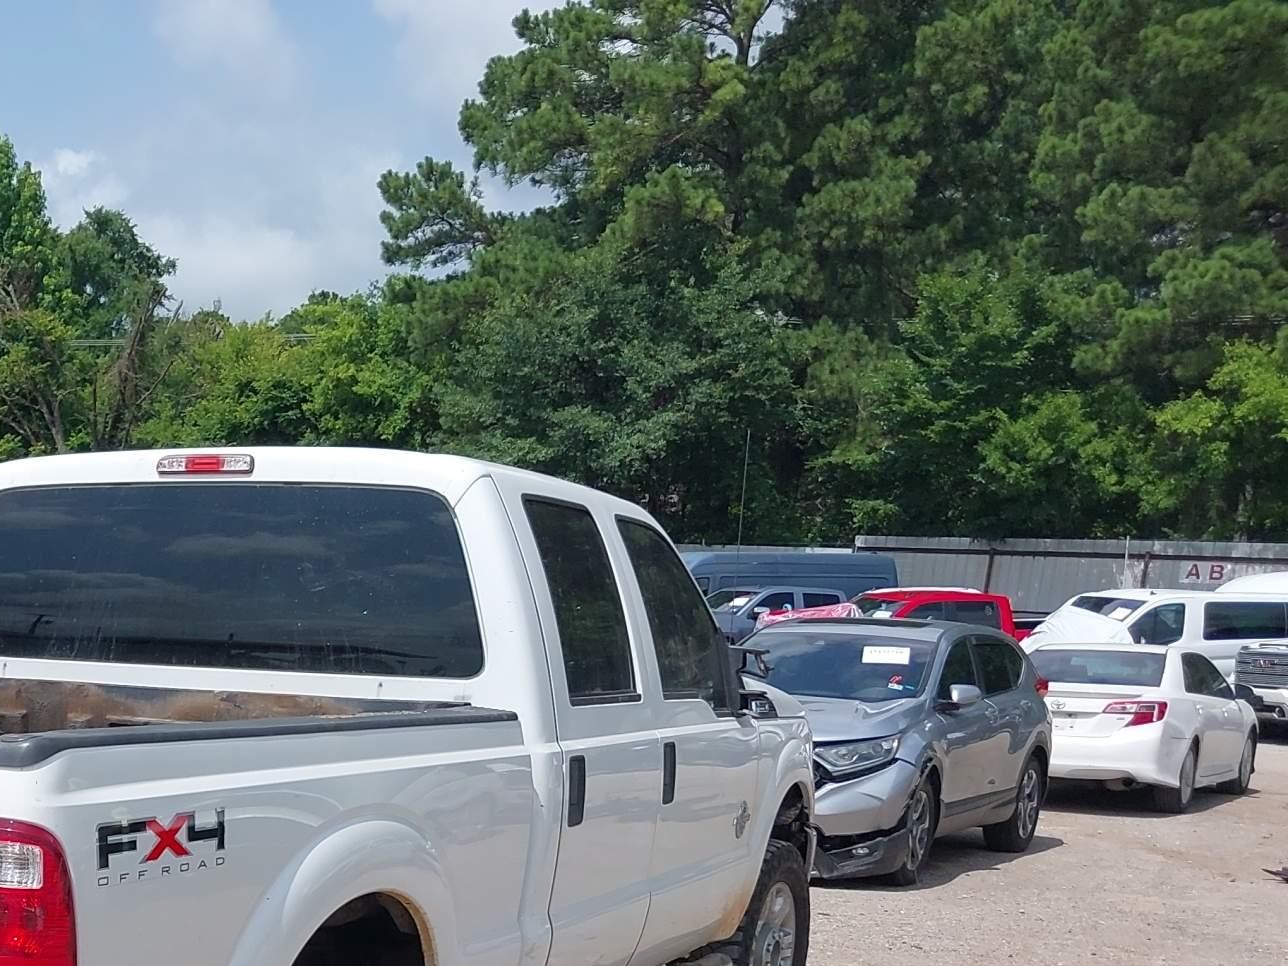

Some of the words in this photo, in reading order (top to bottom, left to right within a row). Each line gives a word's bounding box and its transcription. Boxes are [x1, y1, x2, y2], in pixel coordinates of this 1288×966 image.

[1184, 563, 1201, 580] A
[1208, 564, 1225, 581] B
[96, 807, 226, 870] FX4
[97, 869, 149, 887] OFF
[161, 856, 226, 877] ROAD
